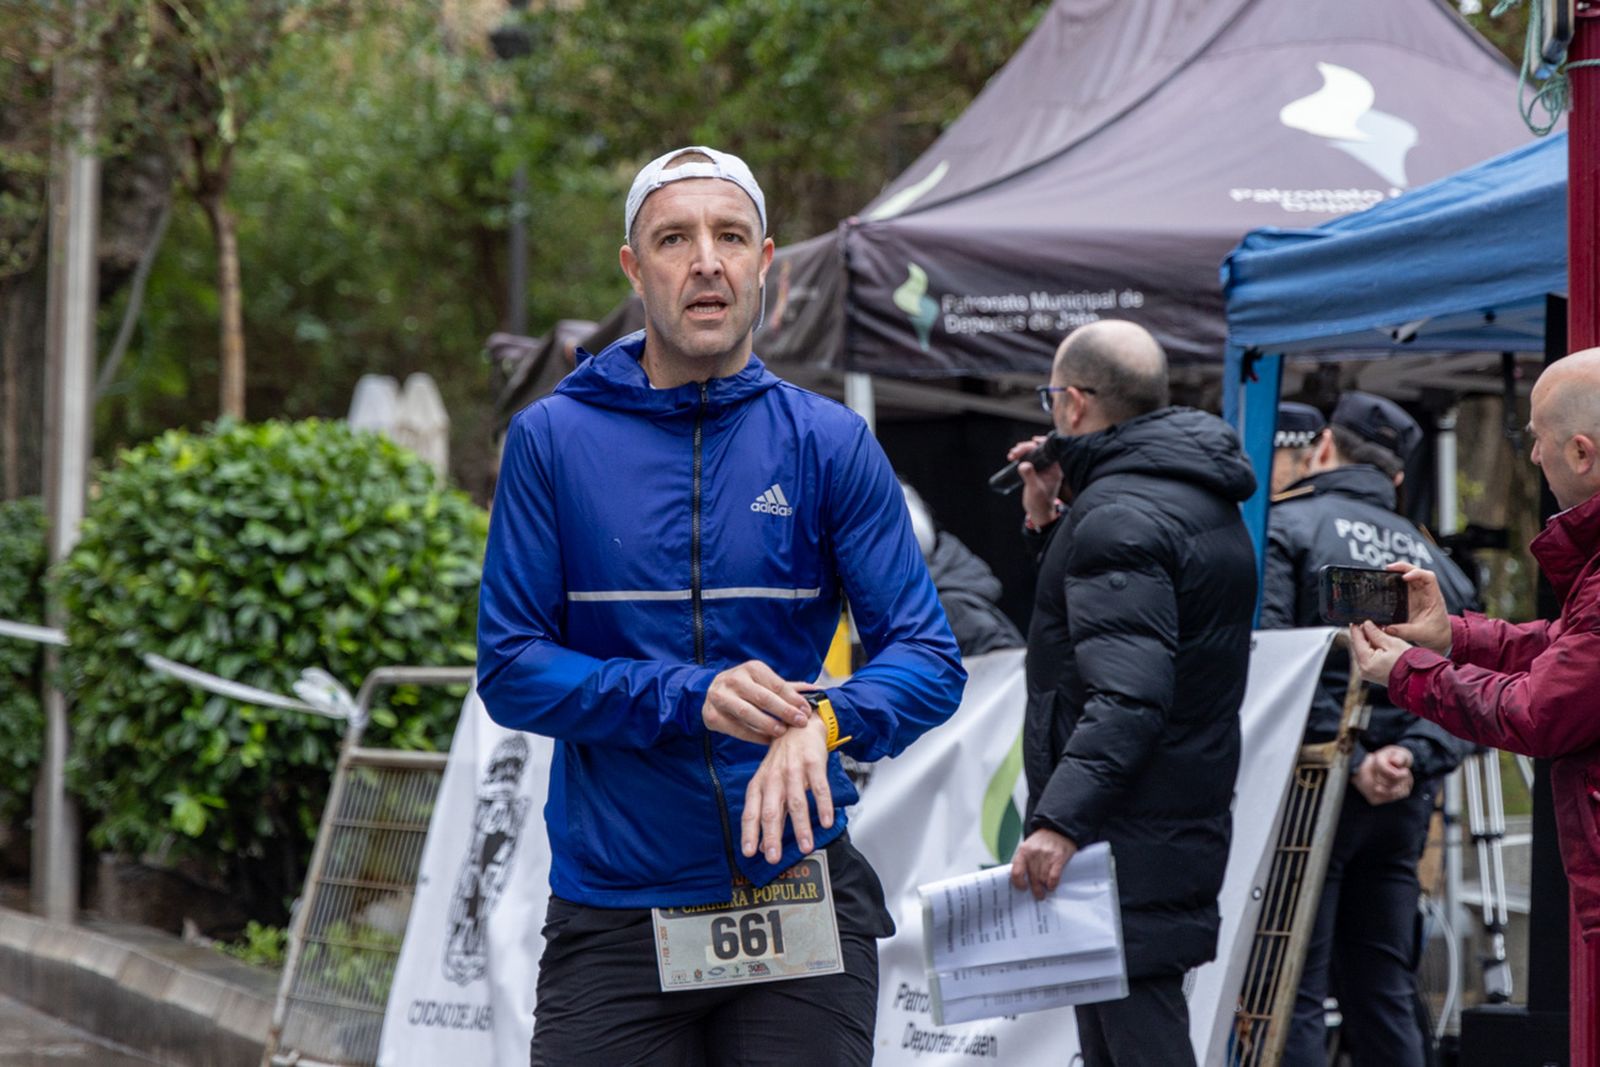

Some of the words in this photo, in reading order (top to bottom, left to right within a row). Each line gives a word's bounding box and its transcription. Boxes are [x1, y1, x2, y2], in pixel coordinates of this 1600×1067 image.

[941, 292, 1029, 314] Patronato
[1029, 290, 1117, 312] Municipal
[1118, 288, 1145, 309] de
[943, 313, 1027, 336] Deportes
[1028, 311, 1054, 332] de
[750, 502, 793, 516] adidas
[752, 882, 818, 905] POPULAR
[711, 909, 784, 961] 661
